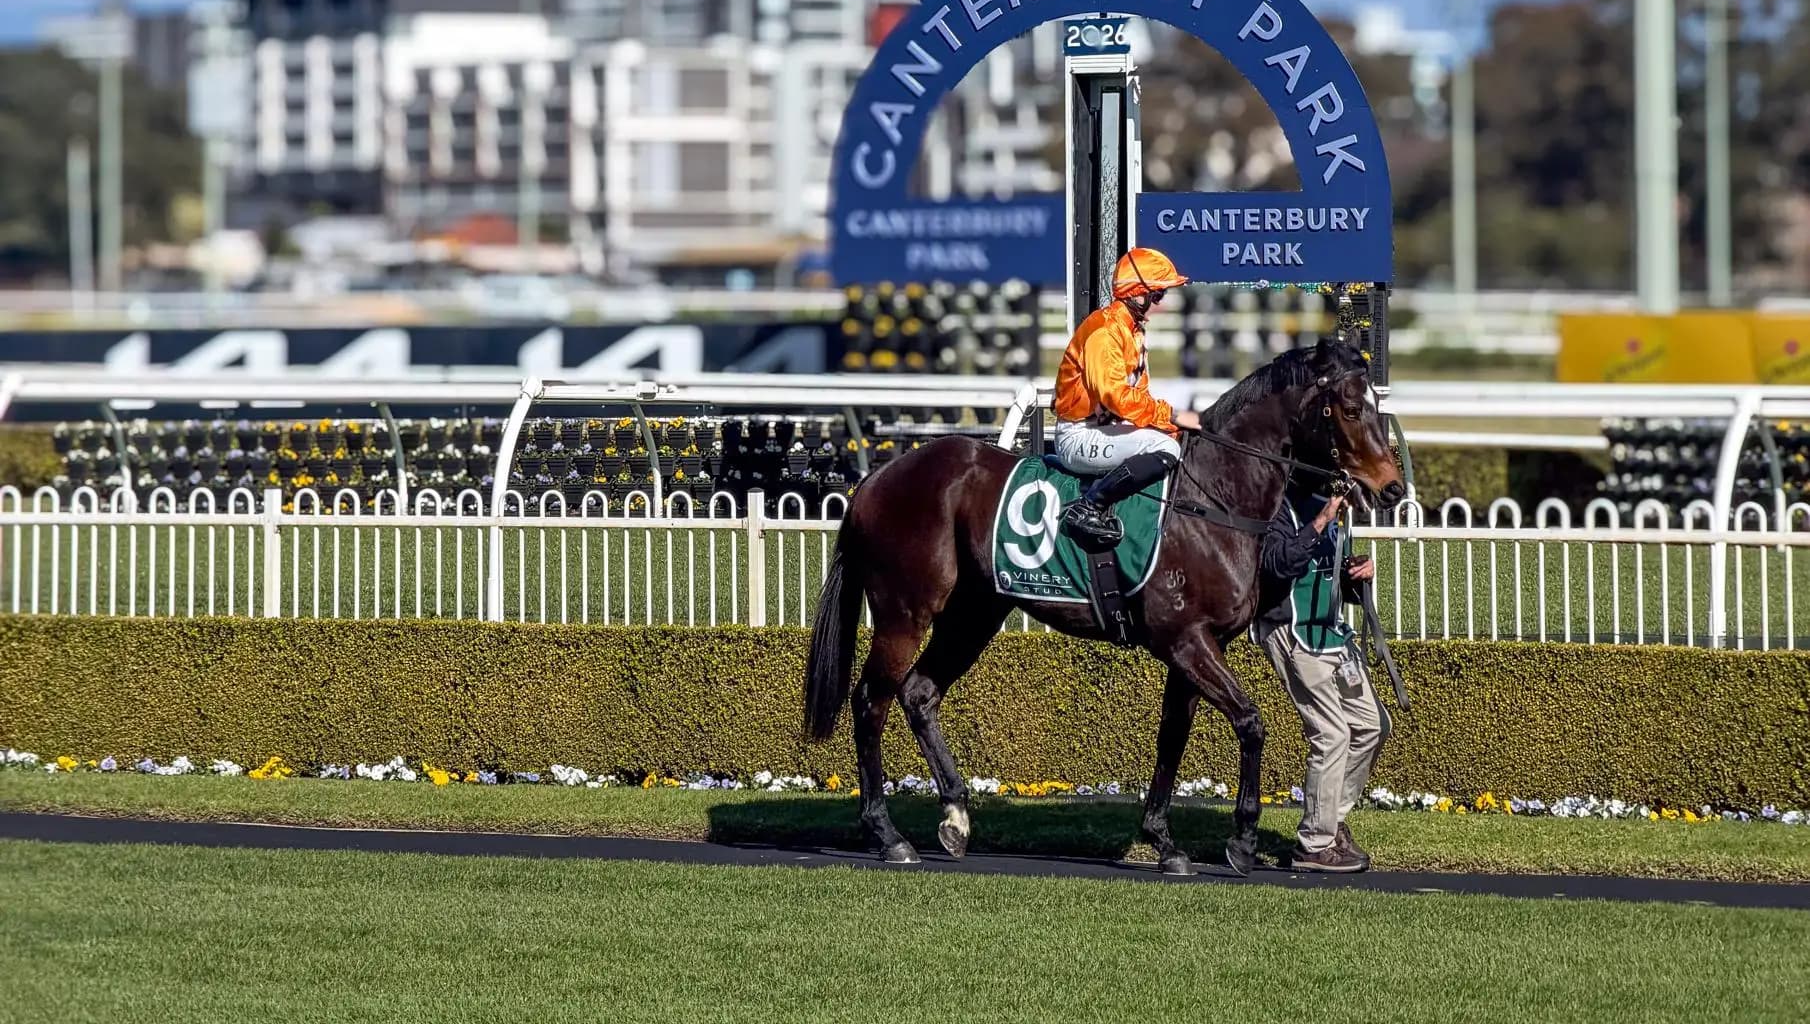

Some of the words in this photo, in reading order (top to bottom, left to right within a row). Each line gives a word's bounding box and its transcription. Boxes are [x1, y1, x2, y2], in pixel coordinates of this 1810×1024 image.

[1238, 2, 1366, 185] PARK
[1157, 207, 1370, 232] CANTERBURY
[1222, 242, 1304, 265] PARK
[1003, 479, 1060, 569] 9
[1013, 571, 1071, 585] VINERY
